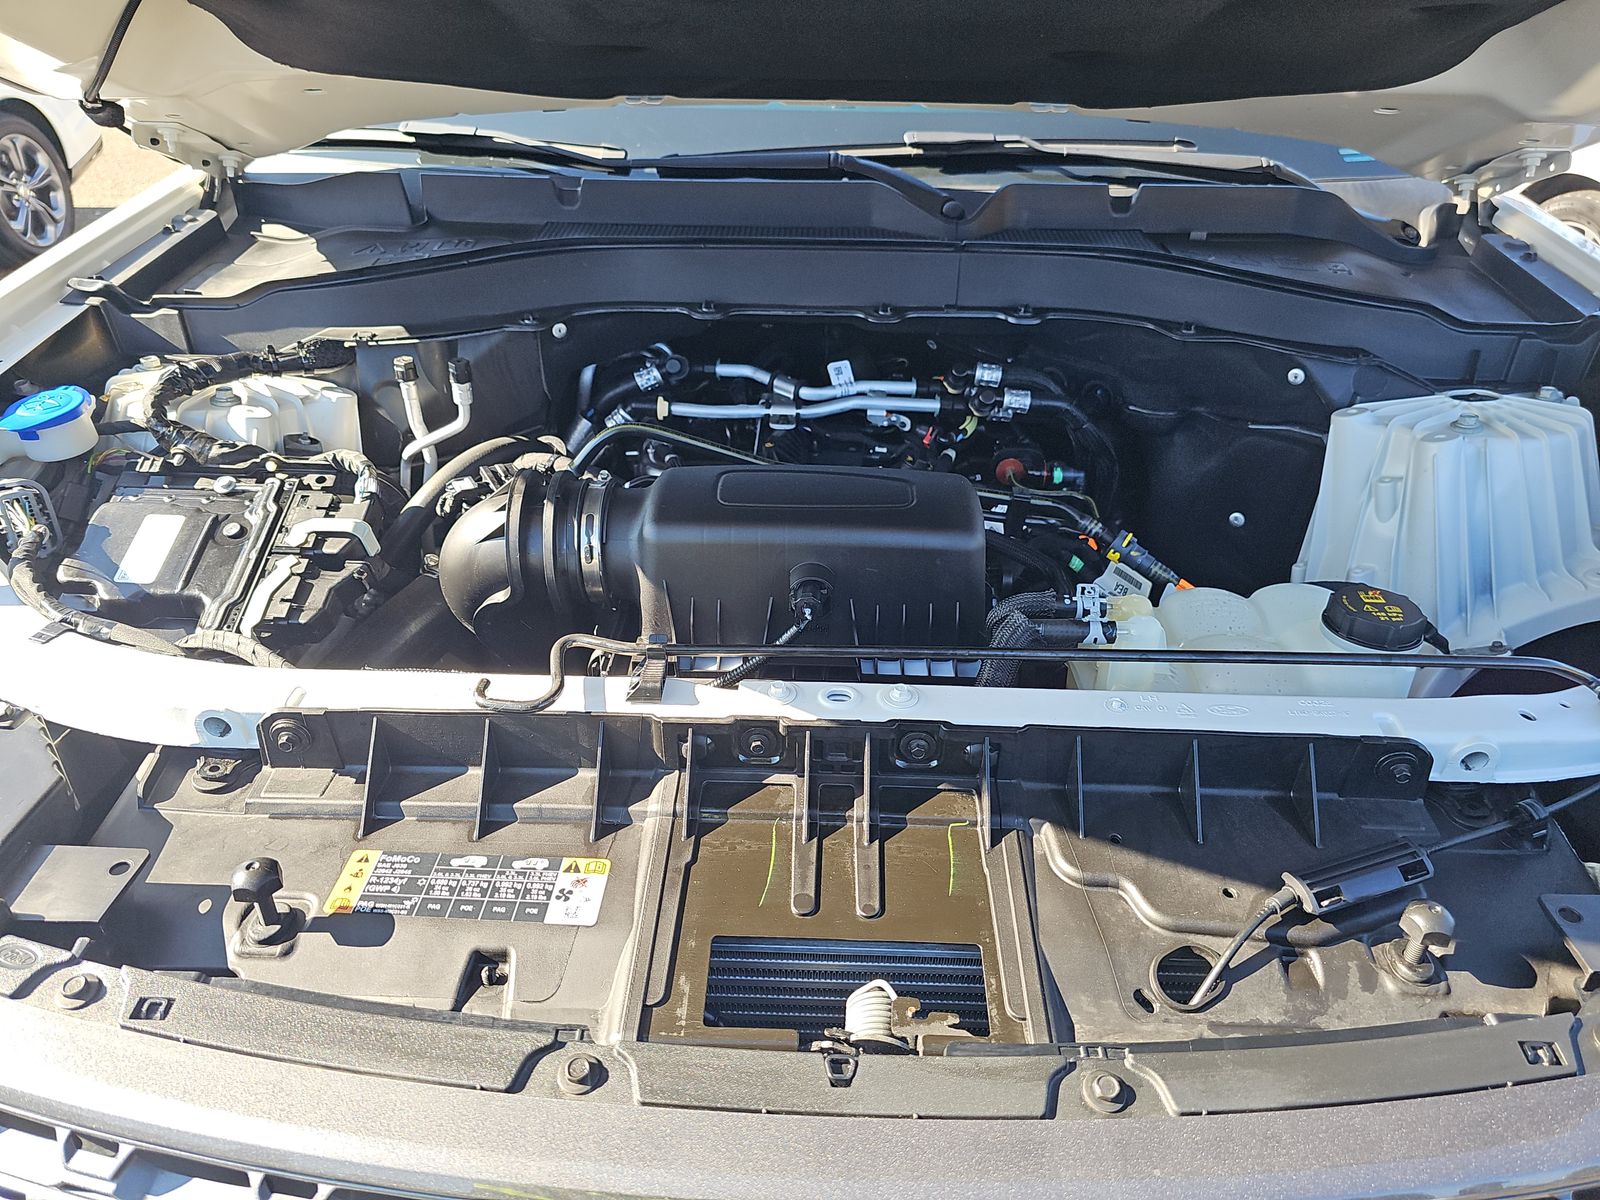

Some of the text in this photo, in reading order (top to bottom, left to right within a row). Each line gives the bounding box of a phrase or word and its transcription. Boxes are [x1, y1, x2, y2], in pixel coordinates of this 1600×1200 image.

[379, 854, 421, 864] FoMoCo
[369, 876, 409, 885] R-1234yf
[365, 885, 391, 894] (GWP
